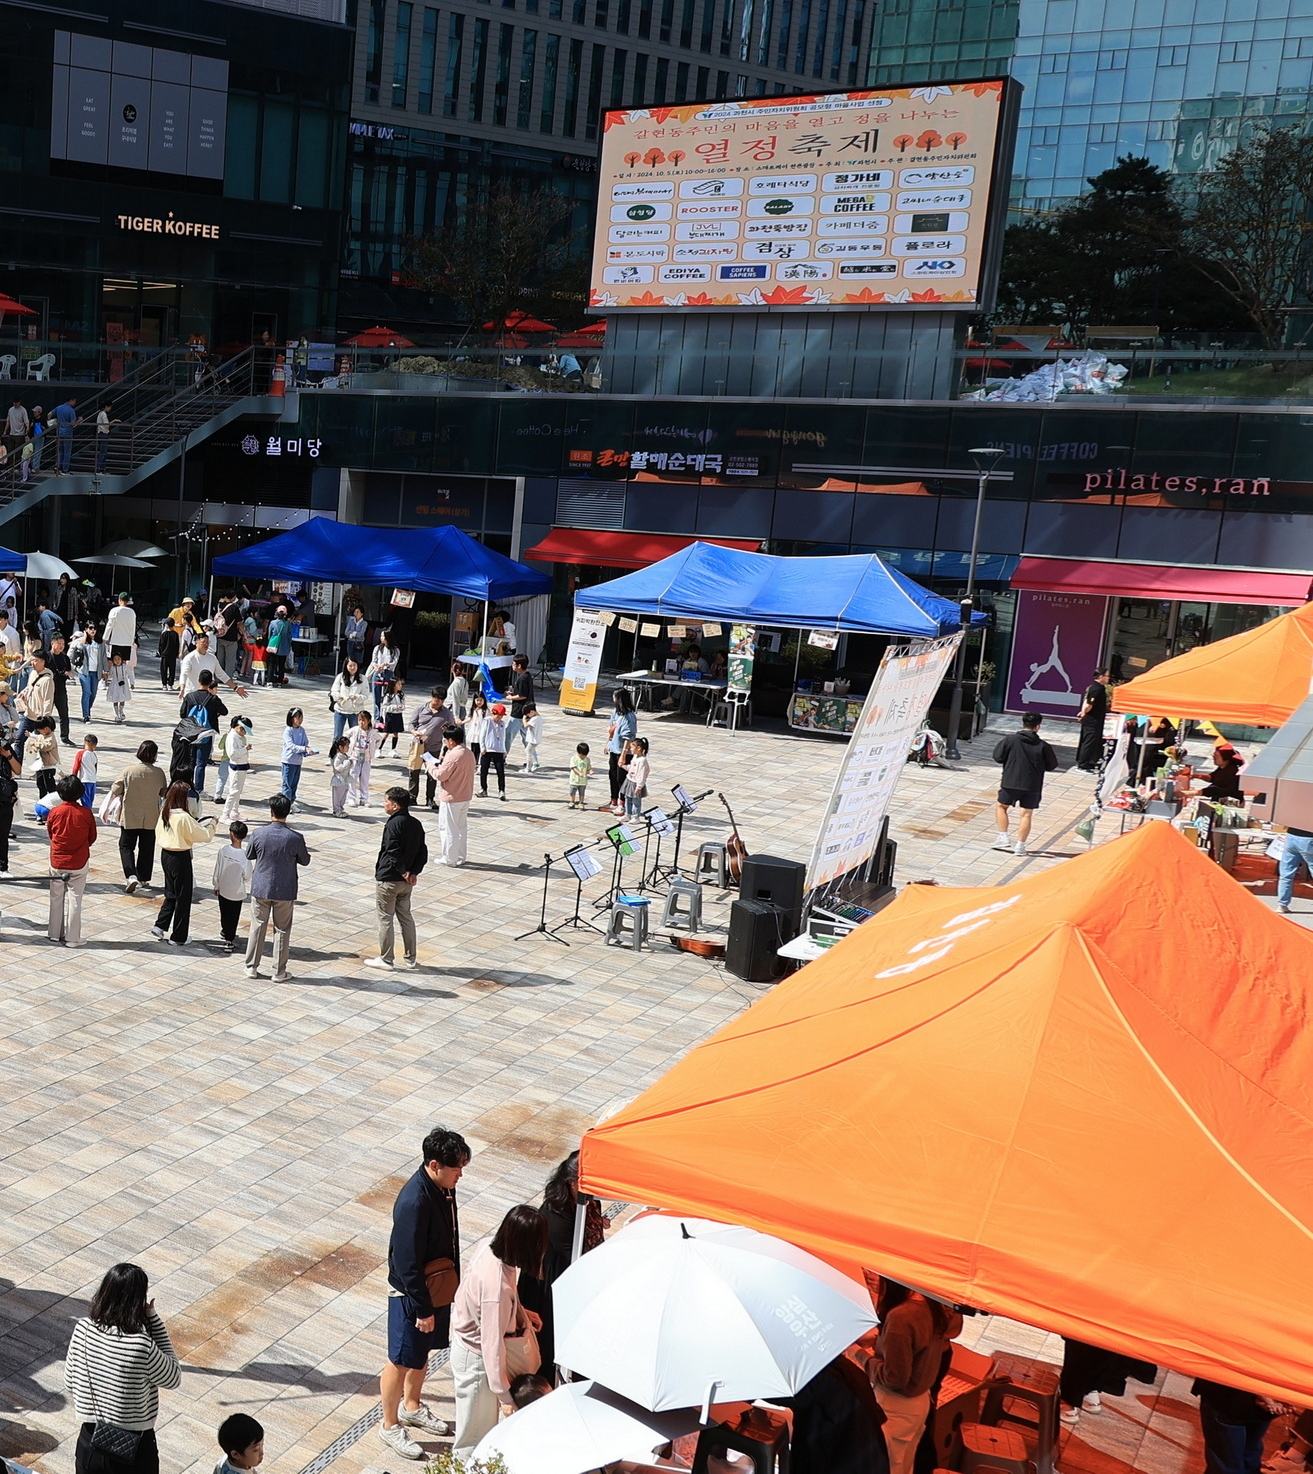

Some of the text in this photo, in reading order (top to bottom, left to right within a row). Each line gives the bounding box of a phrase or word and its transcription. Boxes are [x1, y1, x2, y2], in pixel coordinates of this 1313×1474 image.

[634, 109, 960, 140] 갈현동주민의 마음을 열고 정을 나누는
[834, 172, 881, 184] 정가네
[836, 195, 866, 204] MEGA
[681, 205, 739, 214] ROOSTER
[833, 202, 876, 213] COFFEE
[117, 214, 220, 240] TIGER KOFFEE
[904, 240, 953, 251] 플로라
[730, 266, 755, 274] COFFEE
[265, 436, 324, 458] 월미당
